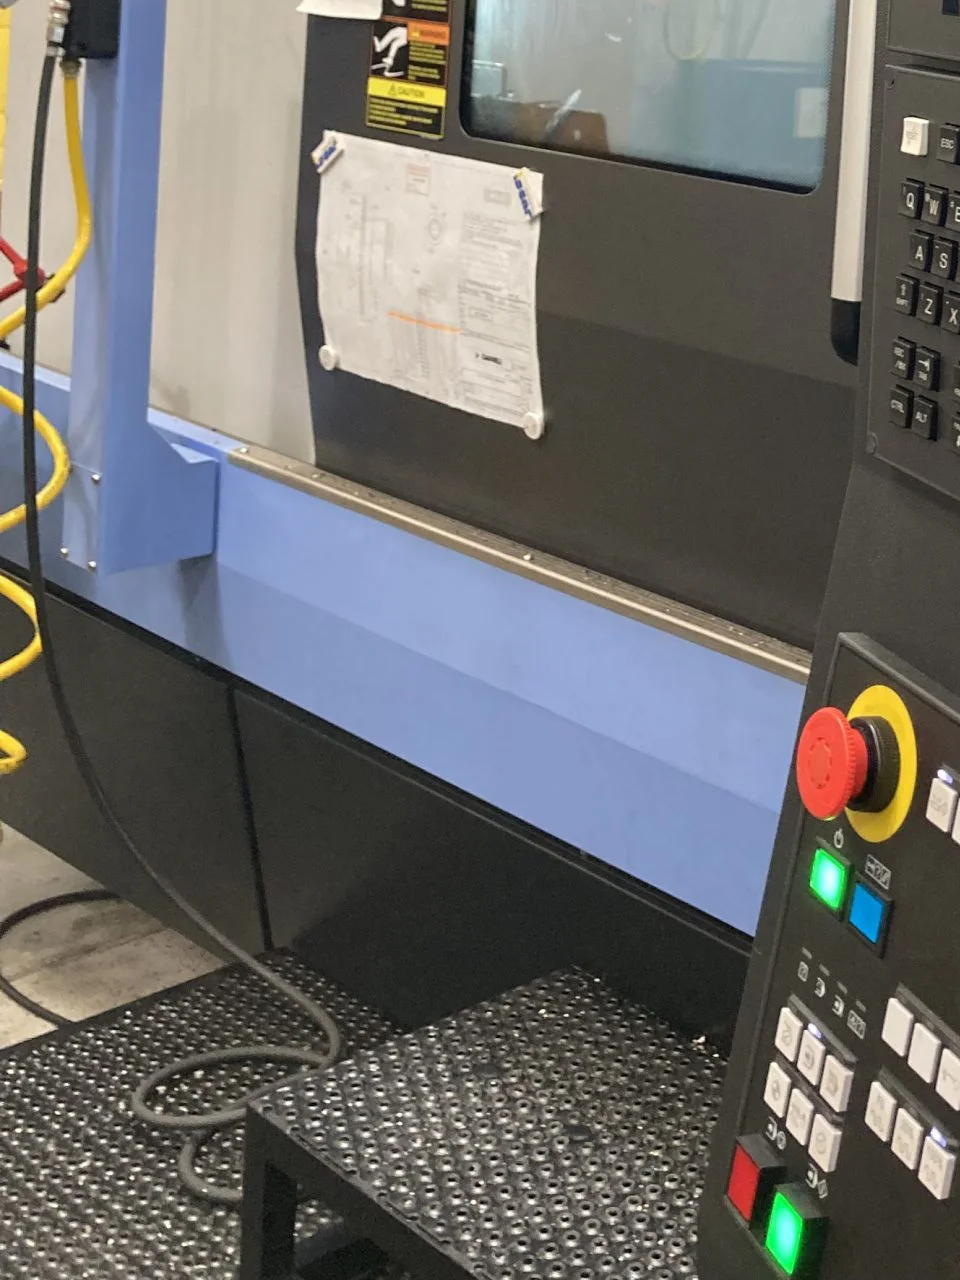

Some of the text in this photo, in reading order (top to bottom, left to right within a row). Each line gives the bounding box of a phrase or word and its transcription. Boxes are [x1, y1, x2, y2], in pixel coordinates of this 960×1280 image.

[940, 138, 954, 149] ESC
[906, 192, 914, 210] Q
[929, 198, 939, 216] W
[915, 245, 924, 261] A
[939, 253, 948, 269] S
[924, 298, 933, 315] Z
[948, 307, 959, 325] X
[915, 411, 928, 424] ALT
